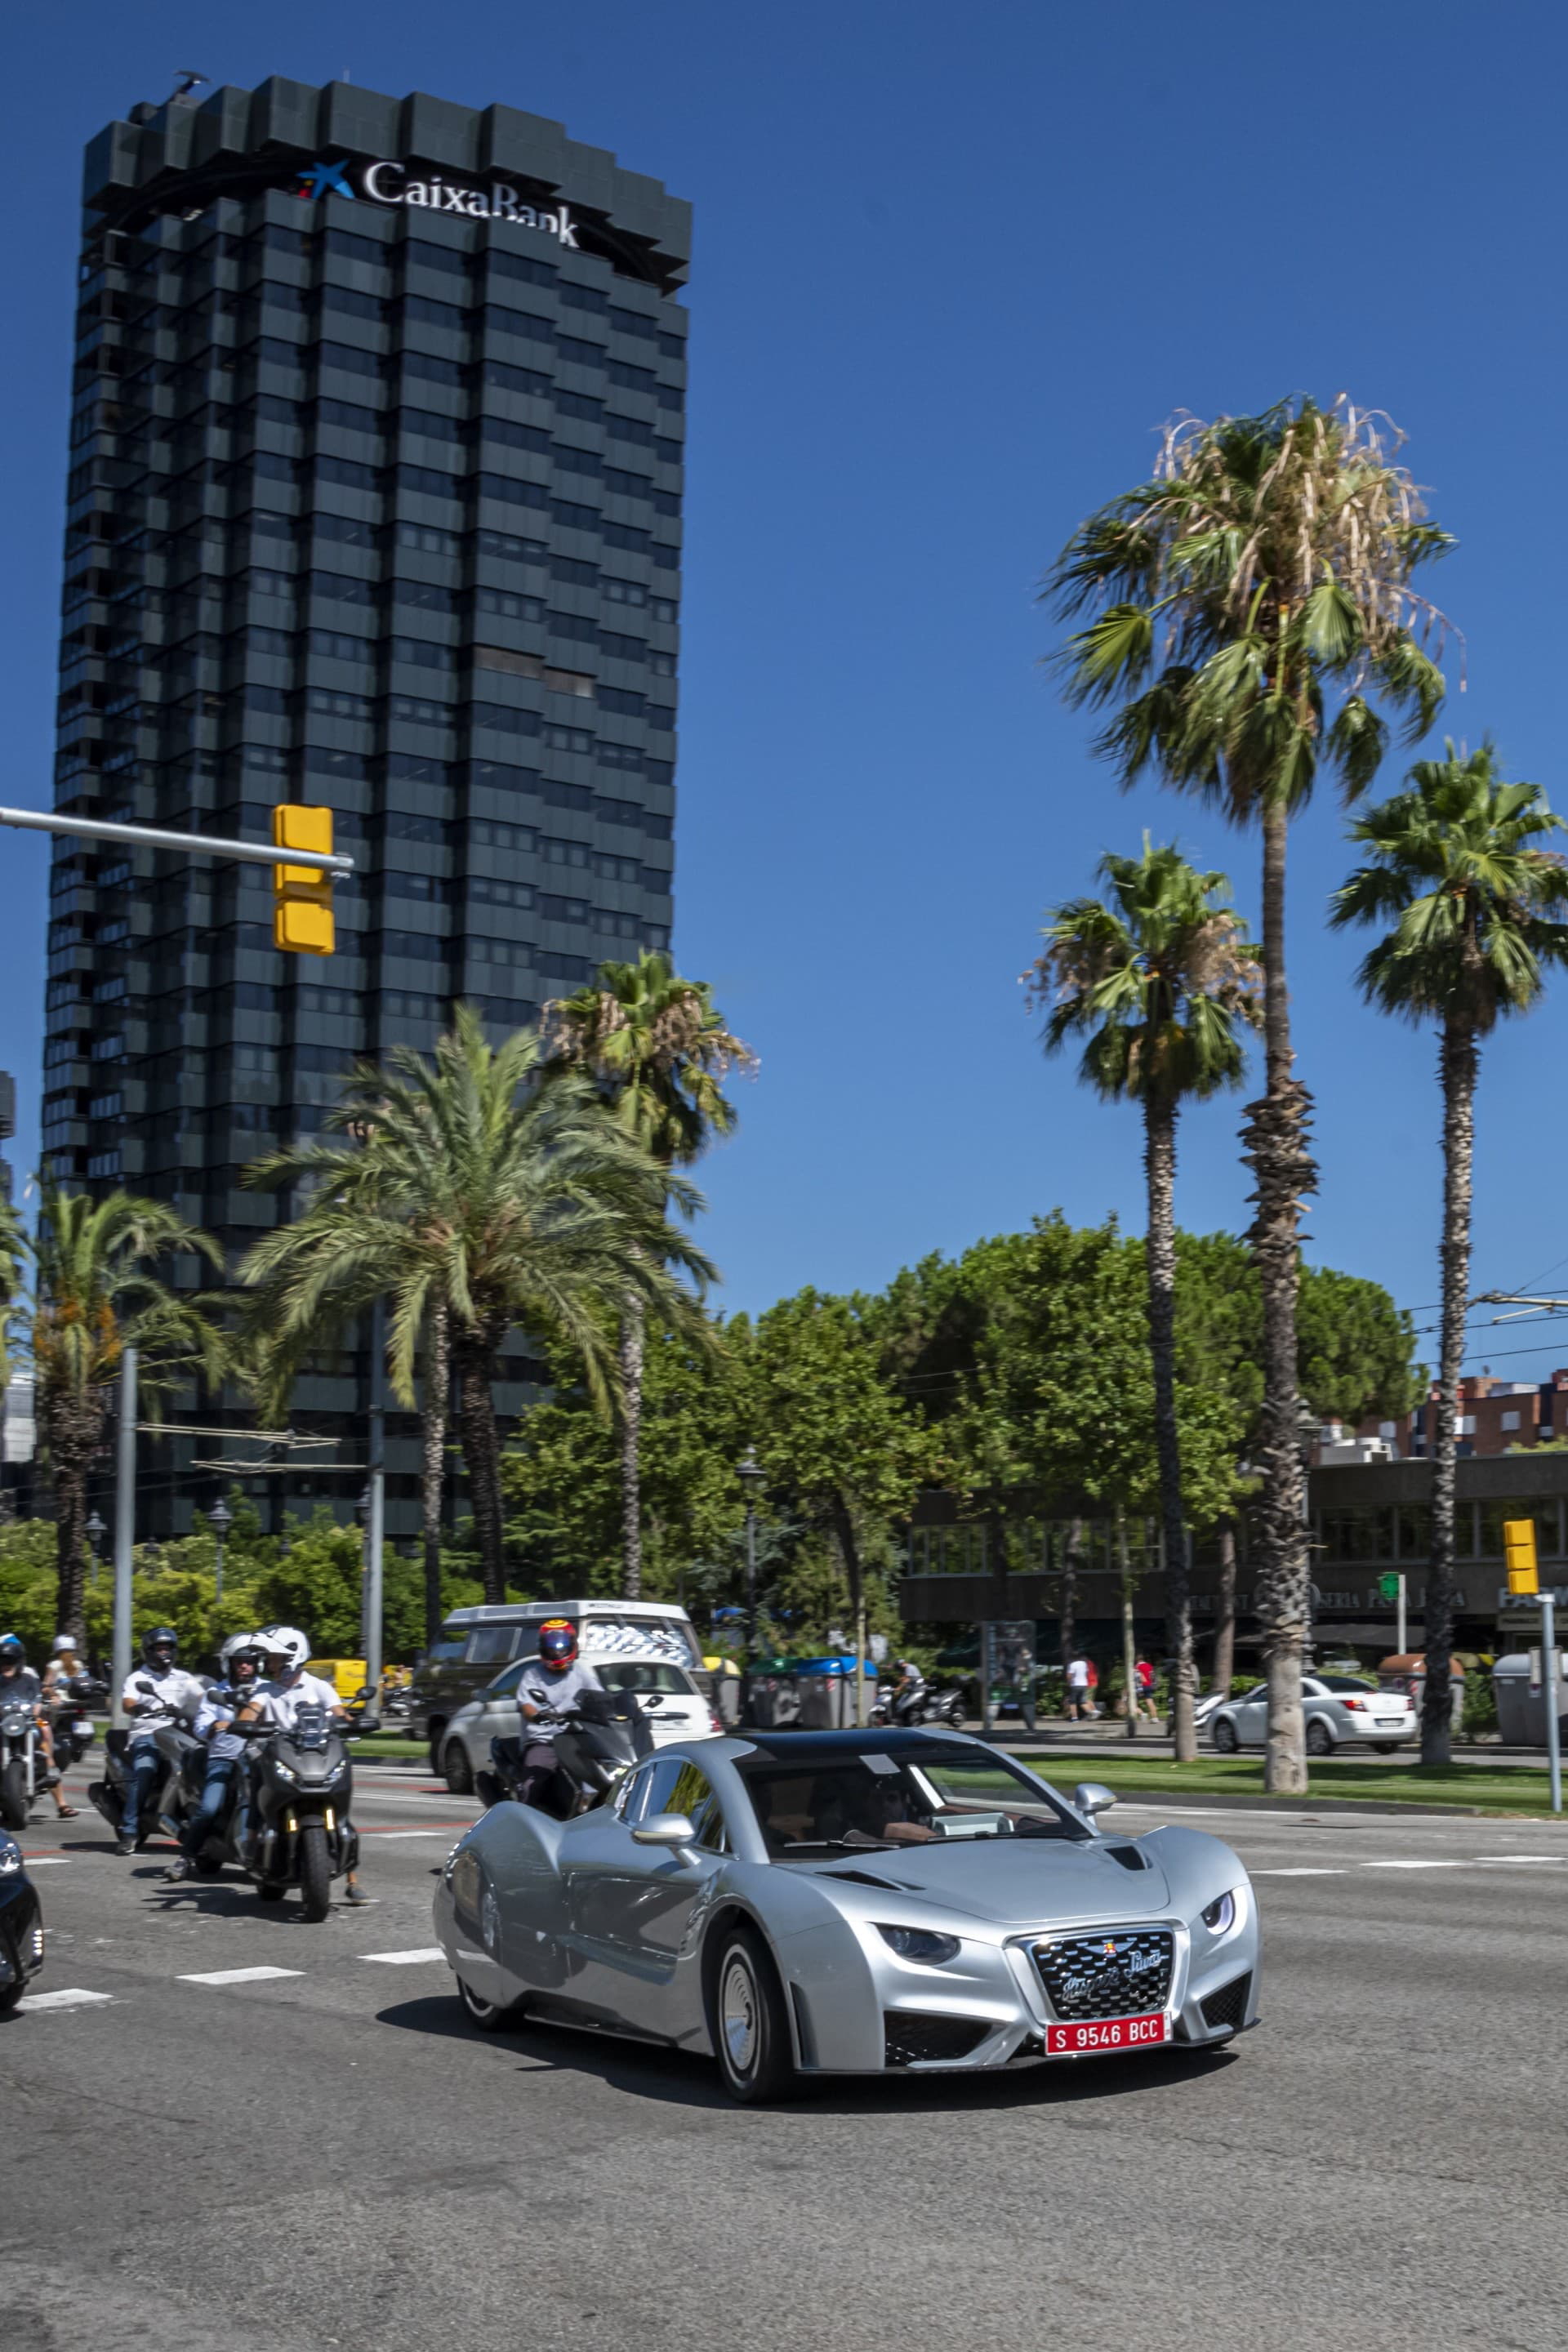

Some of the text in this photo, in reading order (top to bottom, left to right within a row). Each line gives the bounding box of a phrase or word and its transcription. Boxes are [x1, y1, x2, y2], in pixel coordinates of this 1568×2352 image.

[363, 163, 580, 248] CaixaBank
[1055, 2029, 1067, 2049] S
[1076, 2025, 1121, 2047] 9546
[1129, 2019, 1158, 2042] BCC
